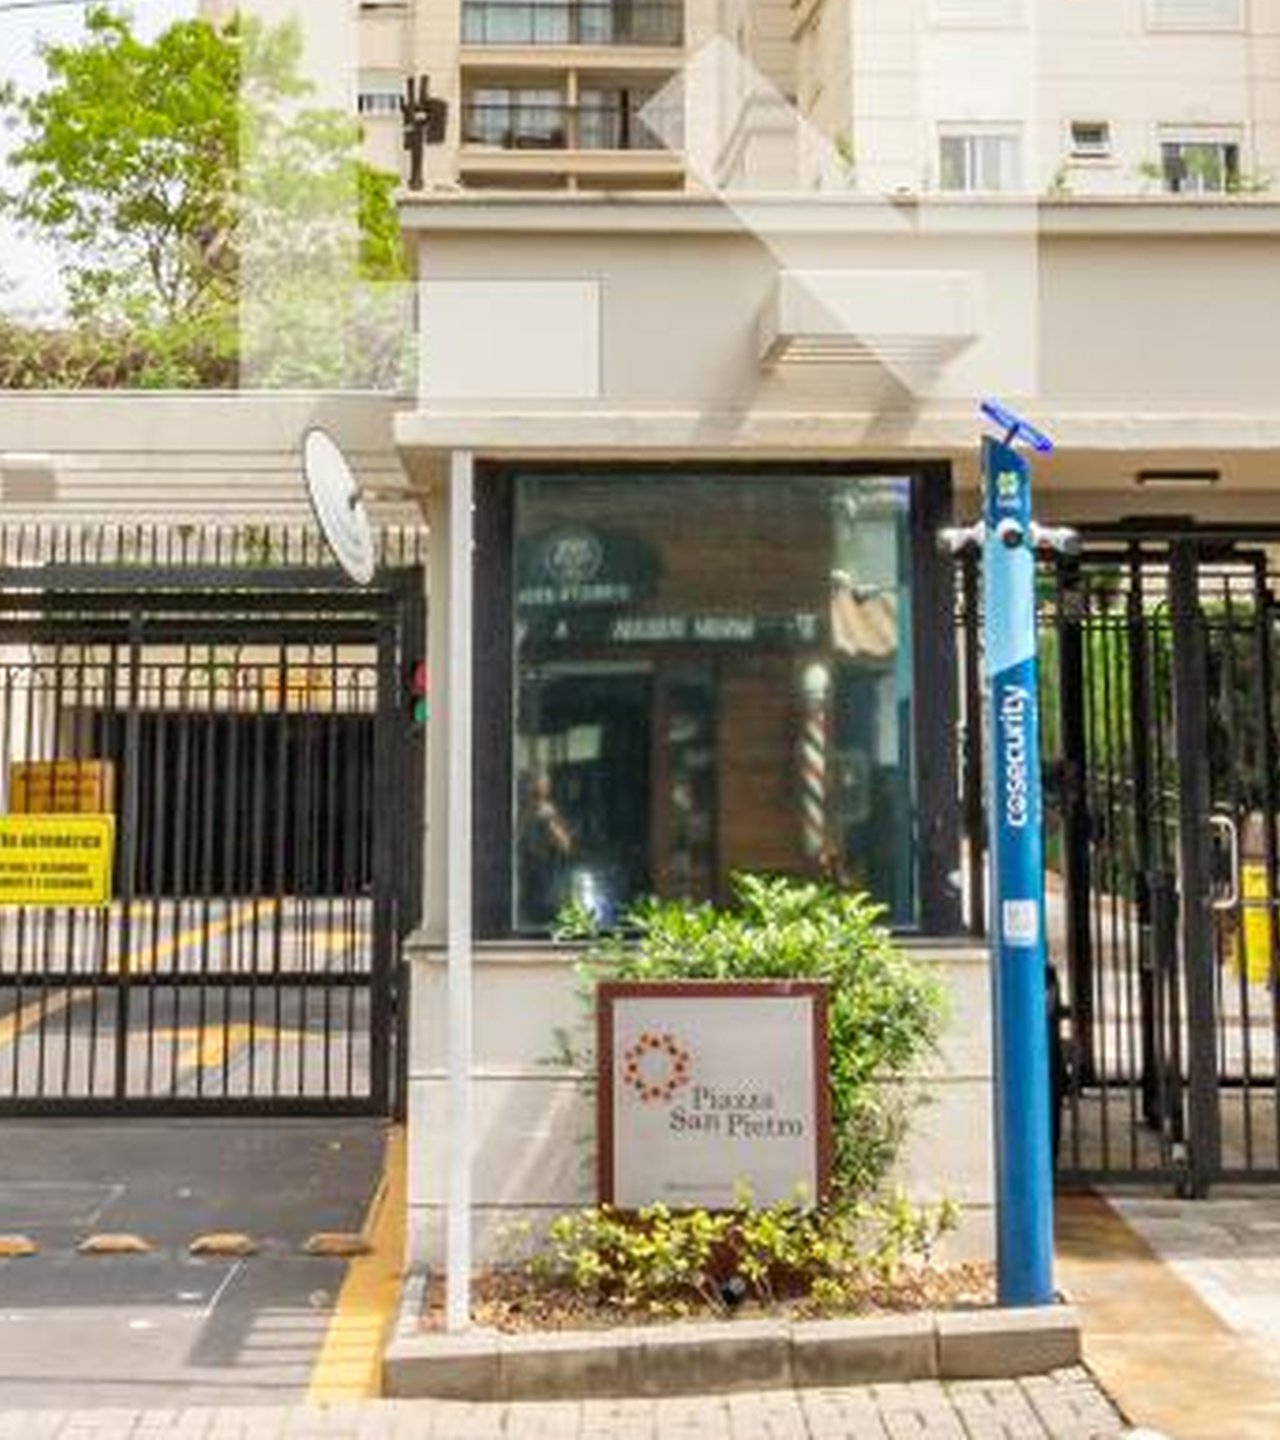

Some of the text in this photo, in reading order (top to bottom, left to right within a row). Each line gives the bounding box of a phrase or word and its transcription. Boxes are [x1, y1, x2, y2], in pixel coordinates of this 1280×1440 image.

[999, 685, 1030, 826] cosecurity
[693, 1086, 773, 1111] Piazza
[669, 1105, 803, 1138] San Pietro
